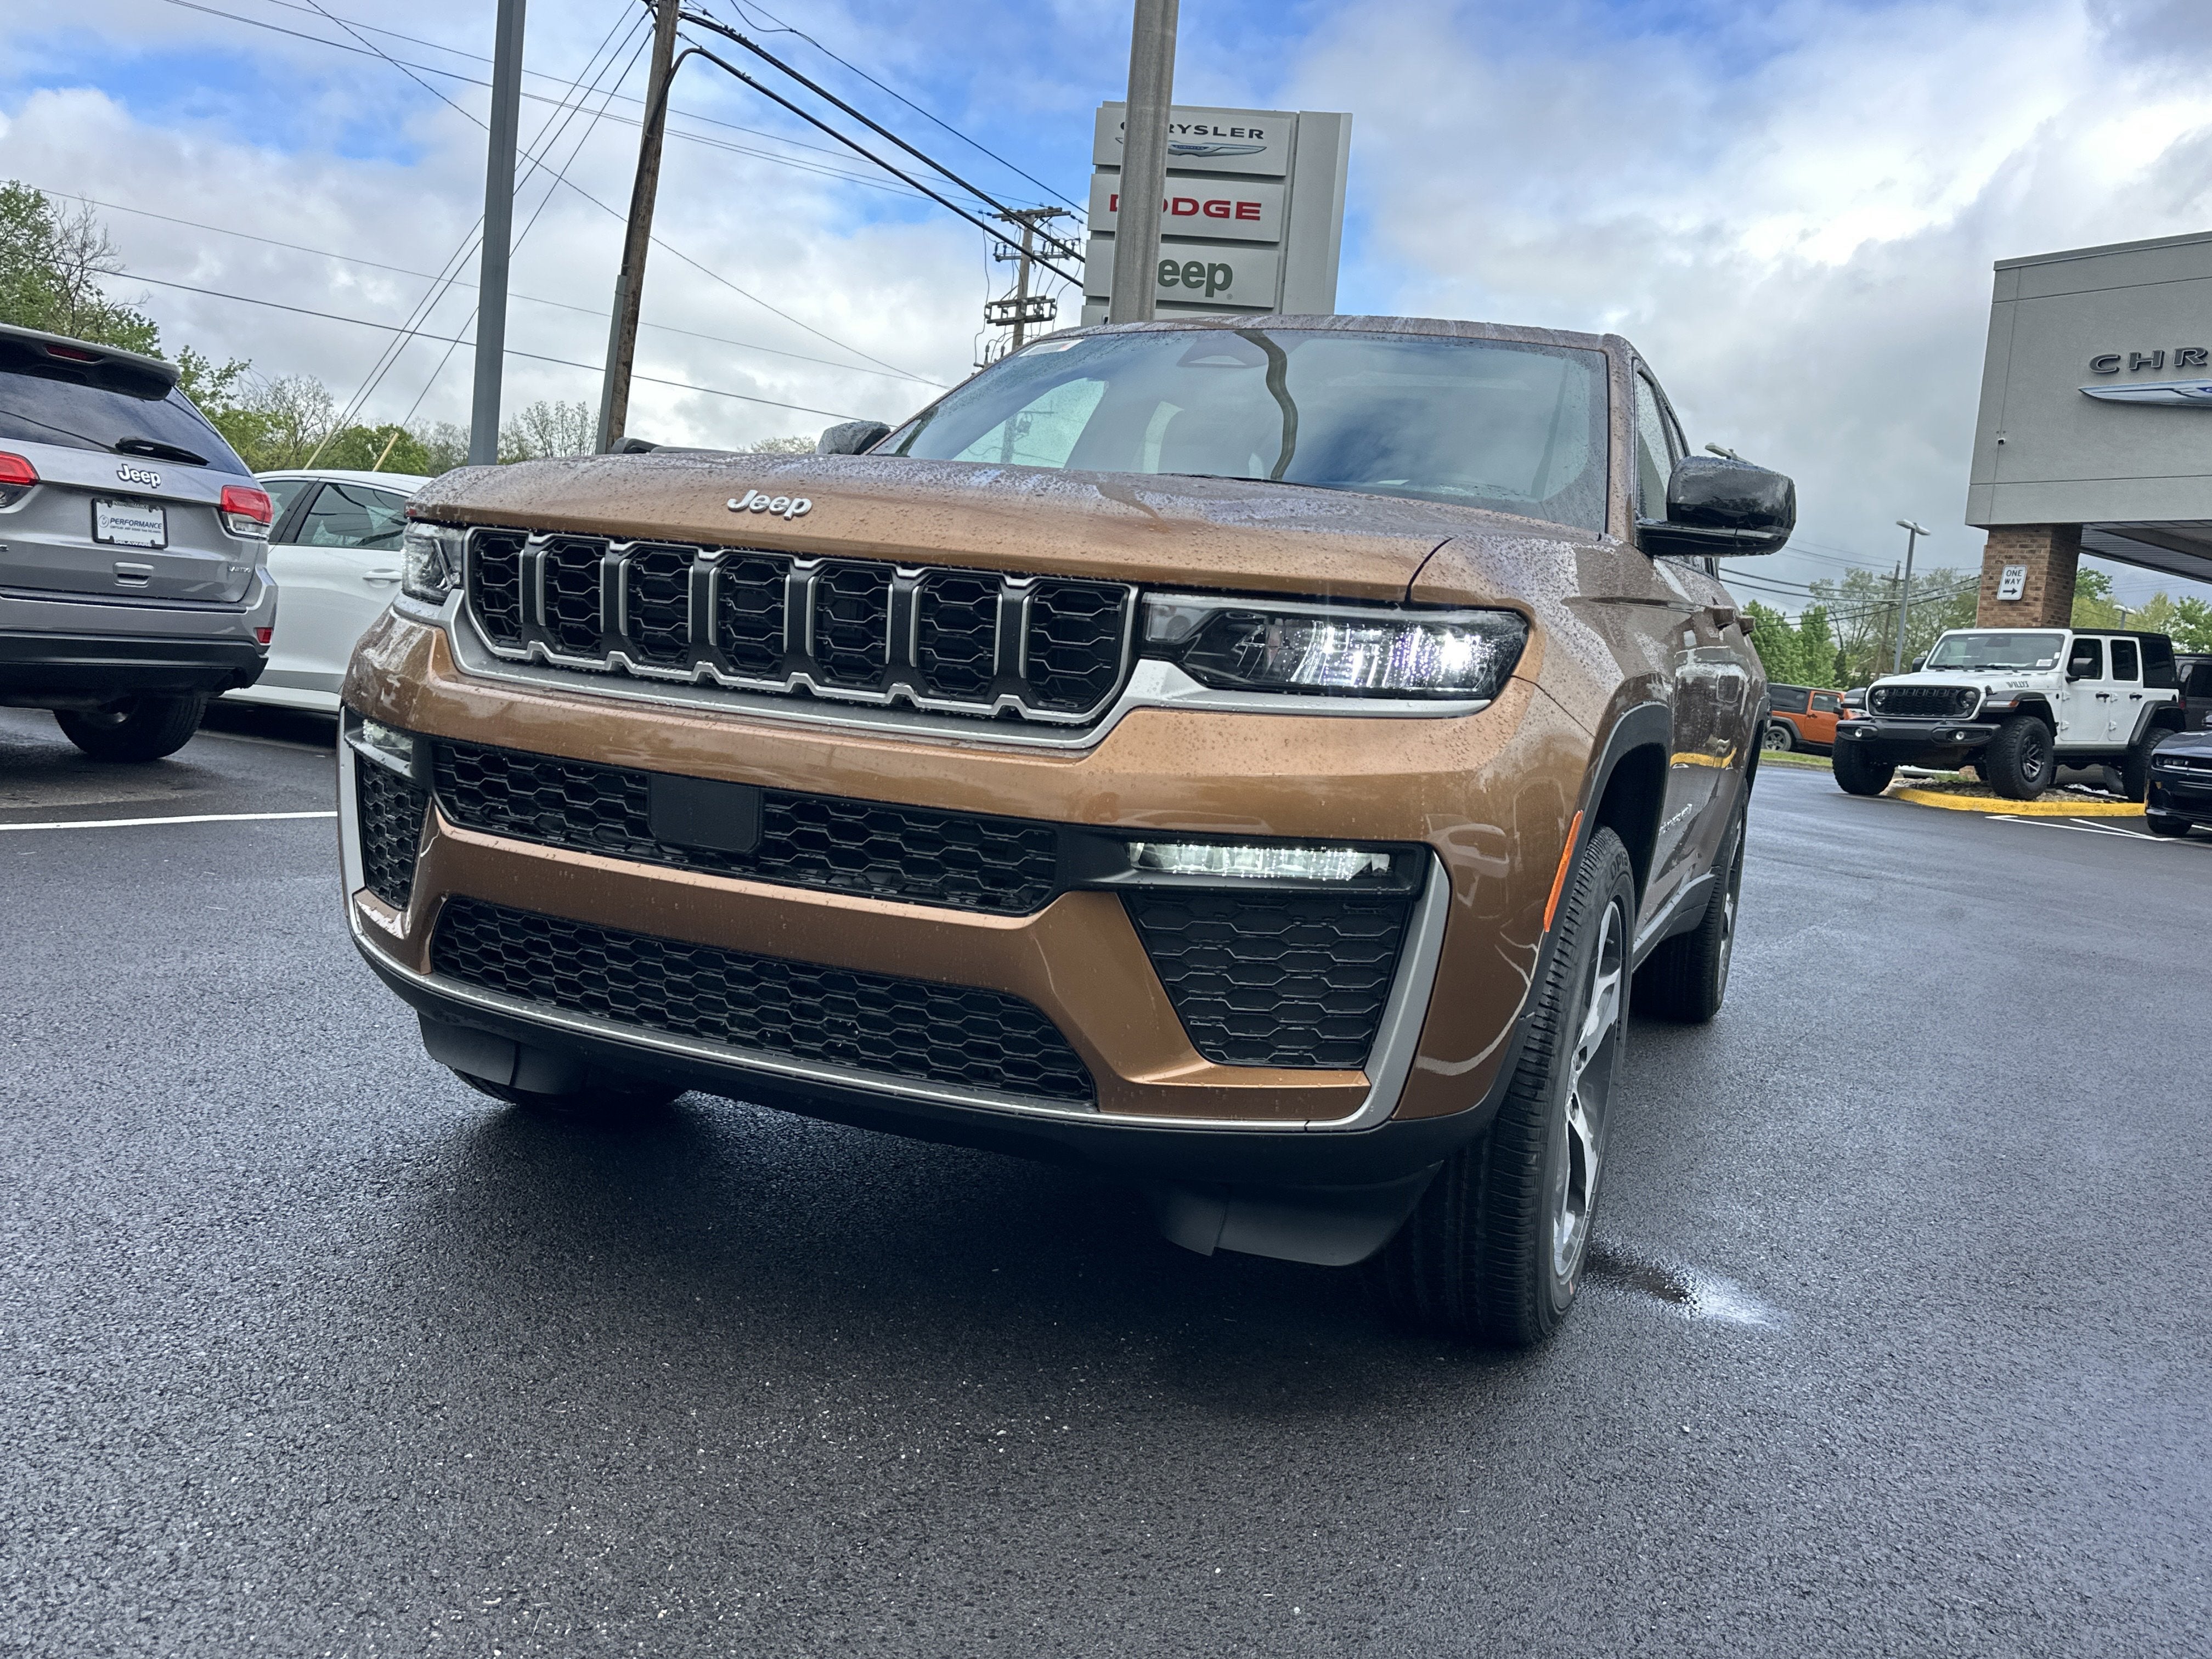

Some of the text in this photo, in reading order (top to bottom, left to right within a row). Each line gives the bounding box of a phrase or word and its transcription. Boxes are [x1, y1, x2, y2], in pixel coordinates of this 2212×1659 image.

[1120, 121, 1264, 139] YSLER
[1109, 194, 1262, 221] DGE
[1158, 259, 1233, 298] eep
[116, 464, 161, 488] Jeep
[727, 489, 812, 521] Jeep
[110, 517, 162, 529] PERFORMANCE
